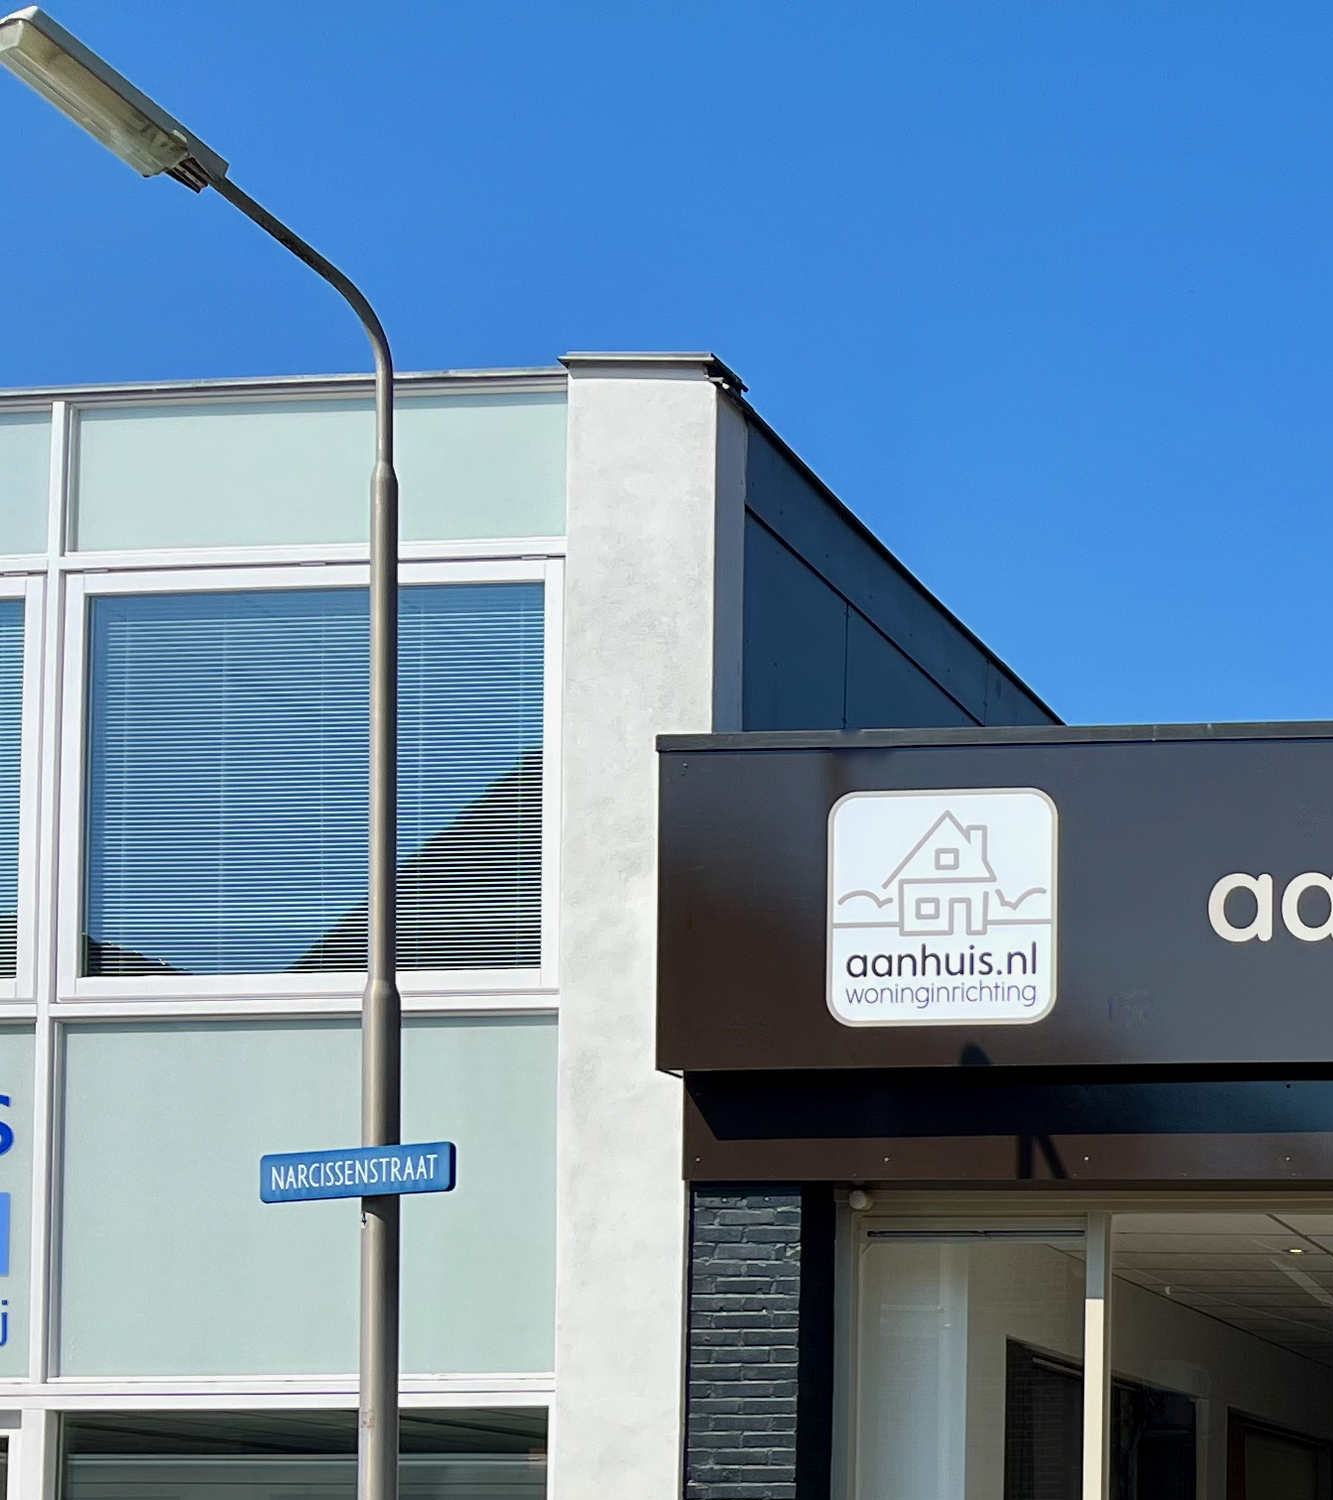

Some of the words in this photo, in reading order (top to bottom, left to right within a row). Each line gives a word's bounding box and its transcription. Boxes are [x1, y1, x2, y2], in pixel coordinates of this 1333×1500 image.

[845, 941, 1037, 978] aanhuis.nl
[845, 979, 1037, 1009] woninginrichting
[271, 1154, 438, 1191] NARCISSENSTRAAT
